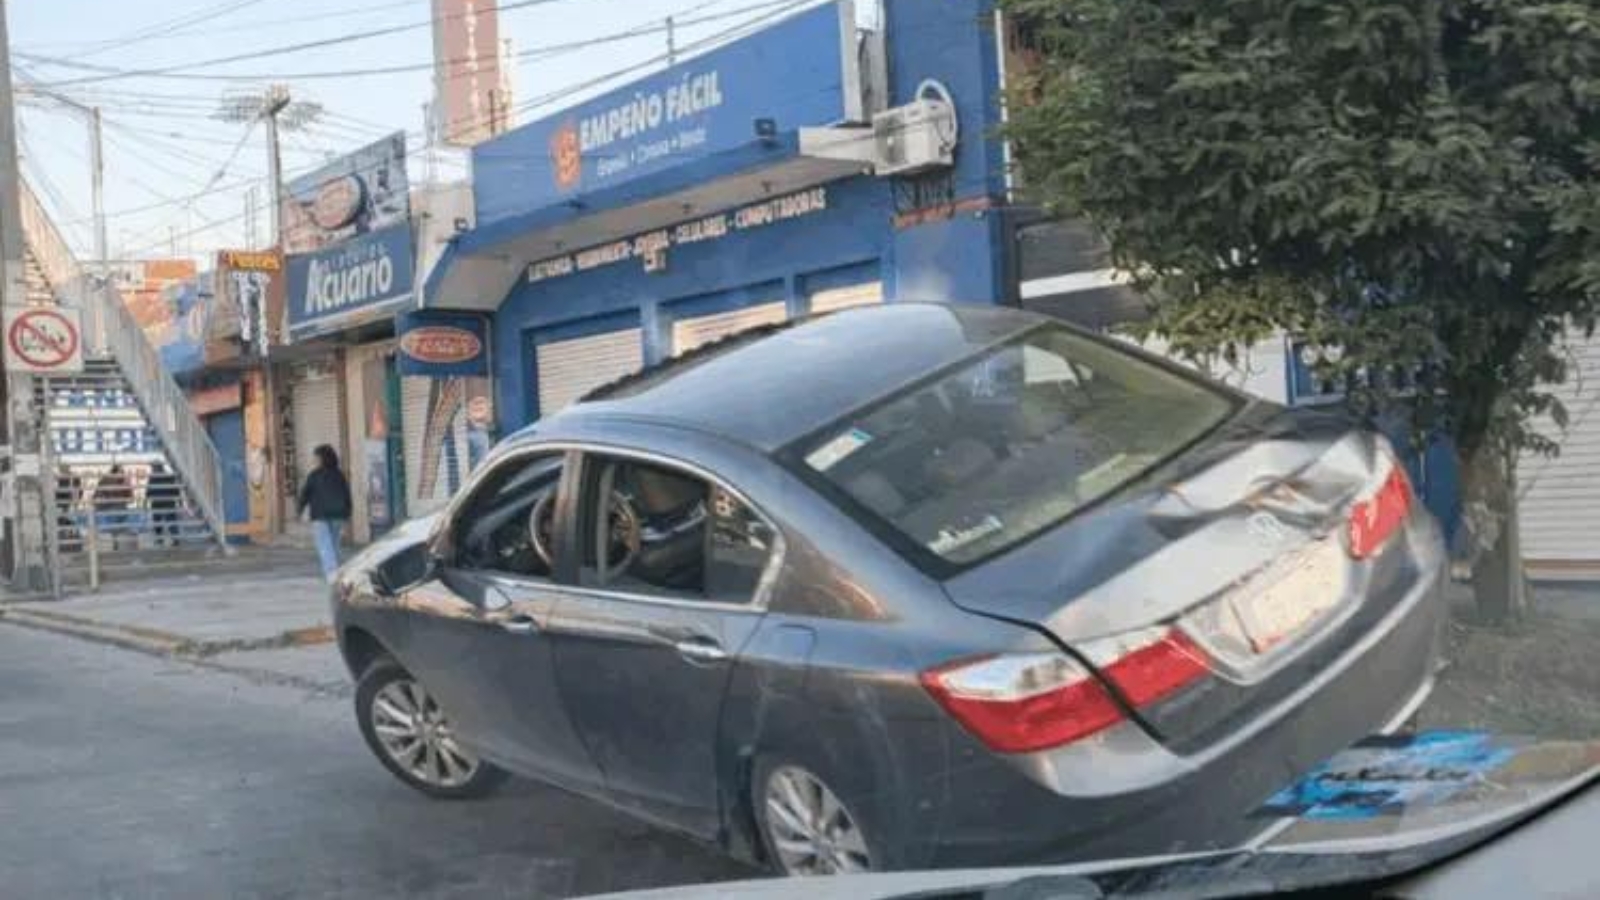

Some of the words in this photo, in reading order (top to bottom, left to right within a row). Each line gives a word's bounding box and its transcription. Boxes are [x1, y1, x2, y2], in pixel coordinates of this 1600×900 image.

[580, 91, 662, 150] EMPEÑO
[666, 70, 723, 122] FÁCIL
[735, 185, 827, 229] COMPUTADORAS
[305, 255, 394, 315] Acuario
